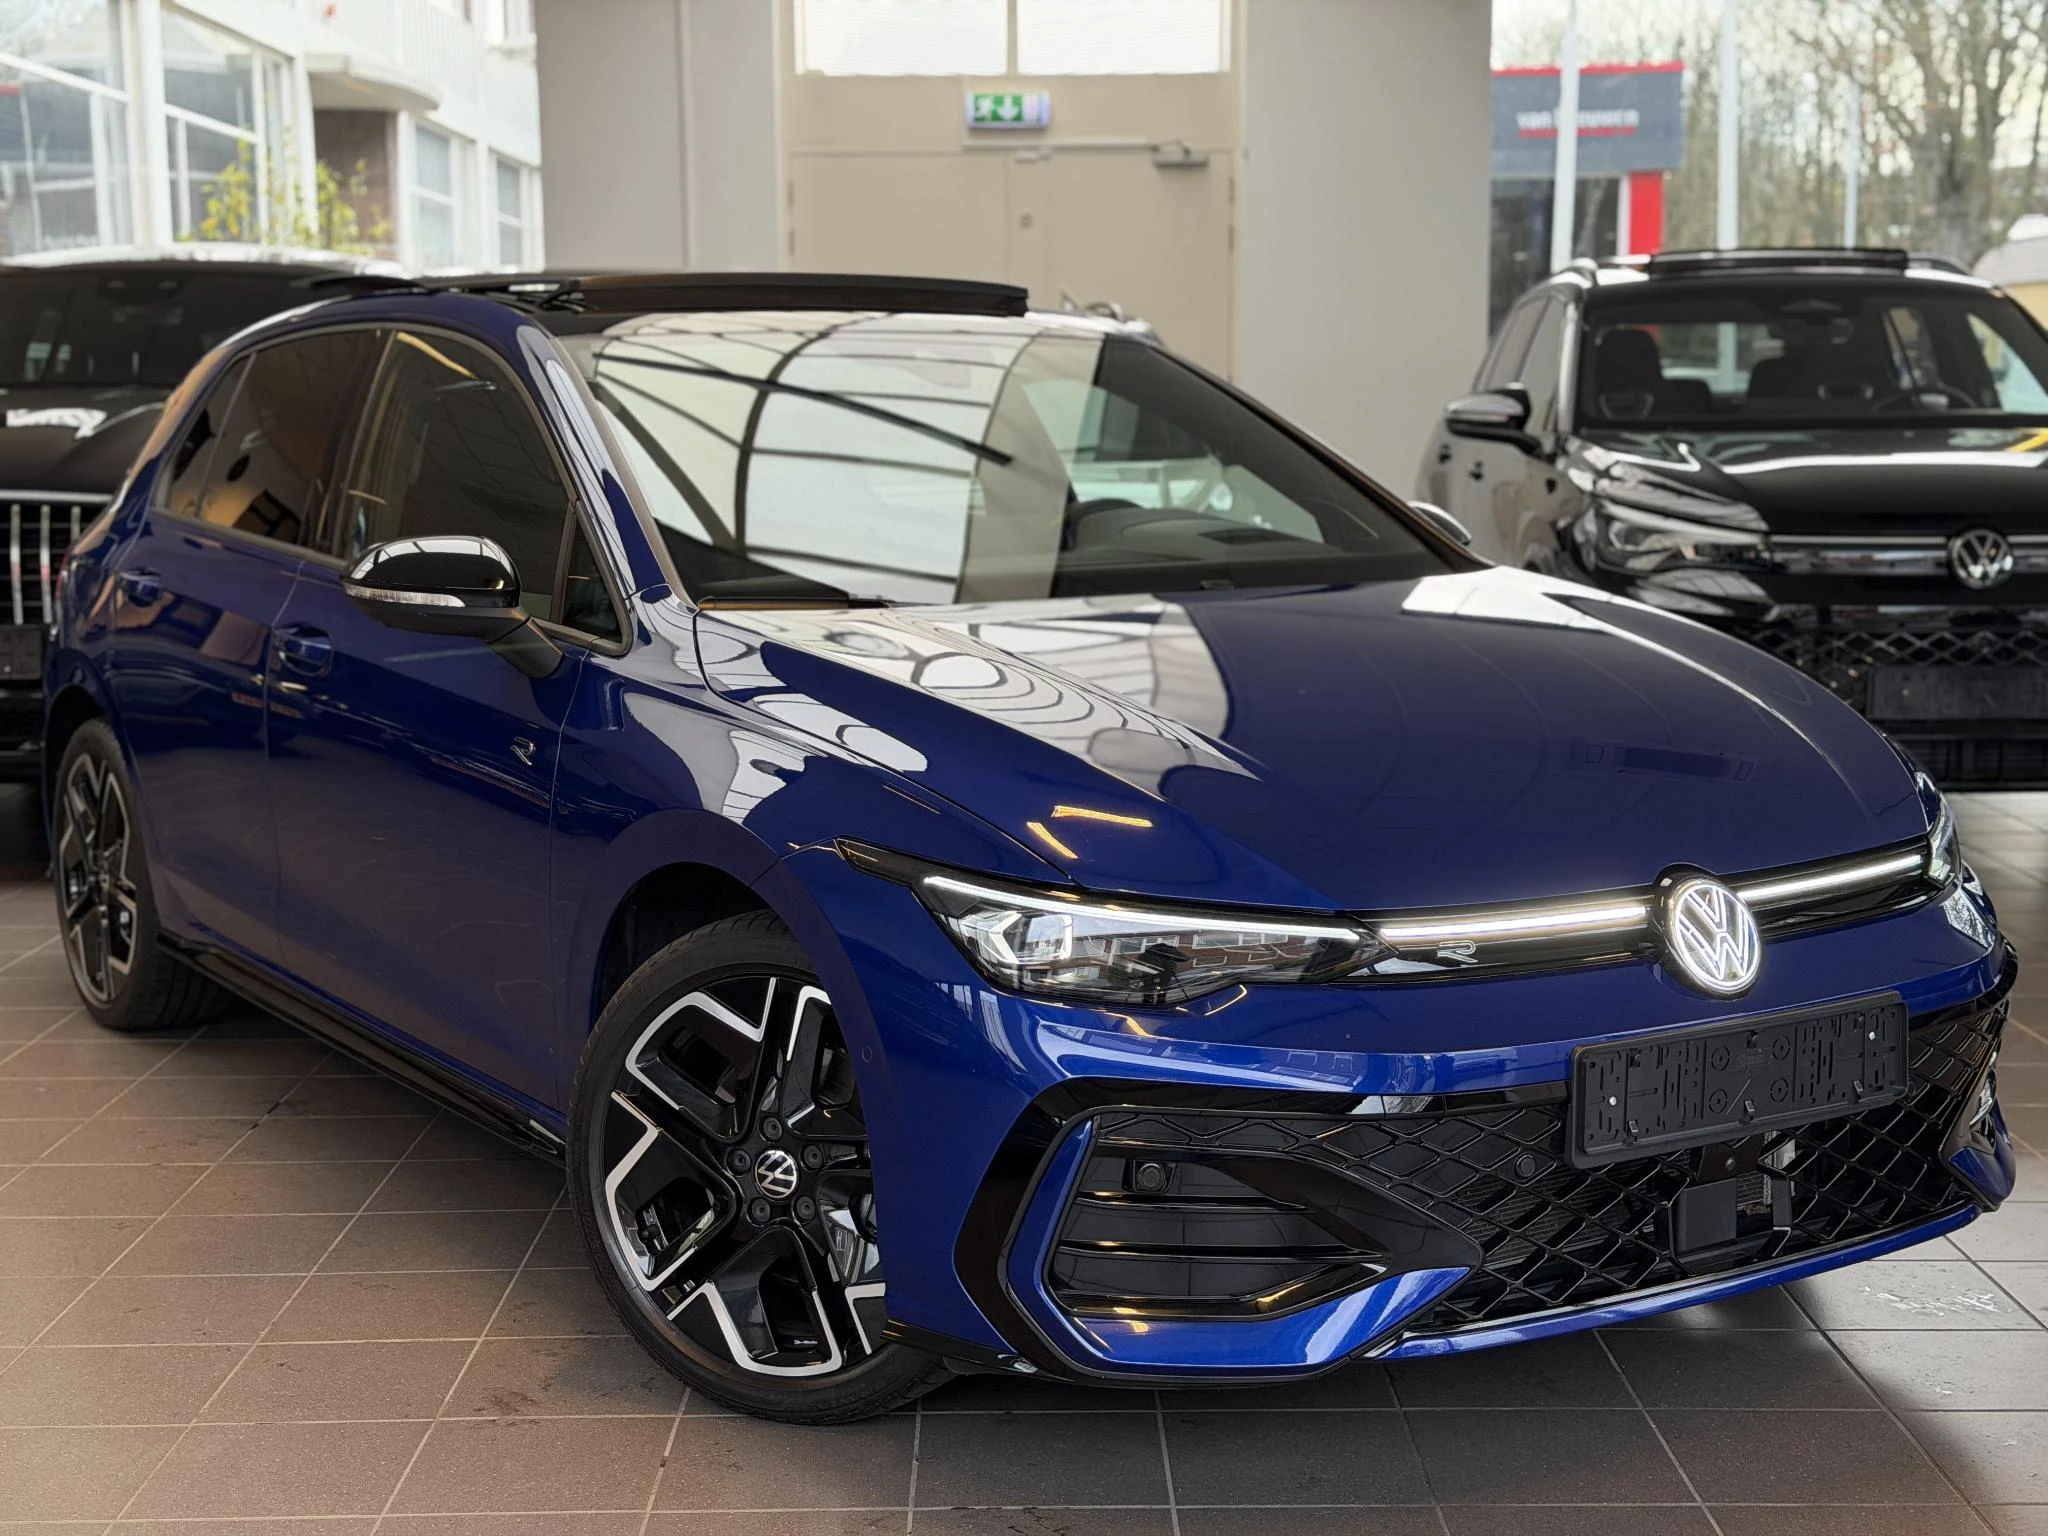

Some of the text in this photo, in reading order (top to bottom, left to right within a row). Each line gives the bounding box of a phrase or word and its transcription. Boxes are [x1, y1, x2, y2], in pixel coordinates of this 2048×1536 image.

[1953, 529, 2012, 588] VW
[510, 736, 536, 766] R
[1437, 939, 1478, 963] R
[1677, 885, 1758, 985] VW
[755, 1149, 797, 1199] VW
